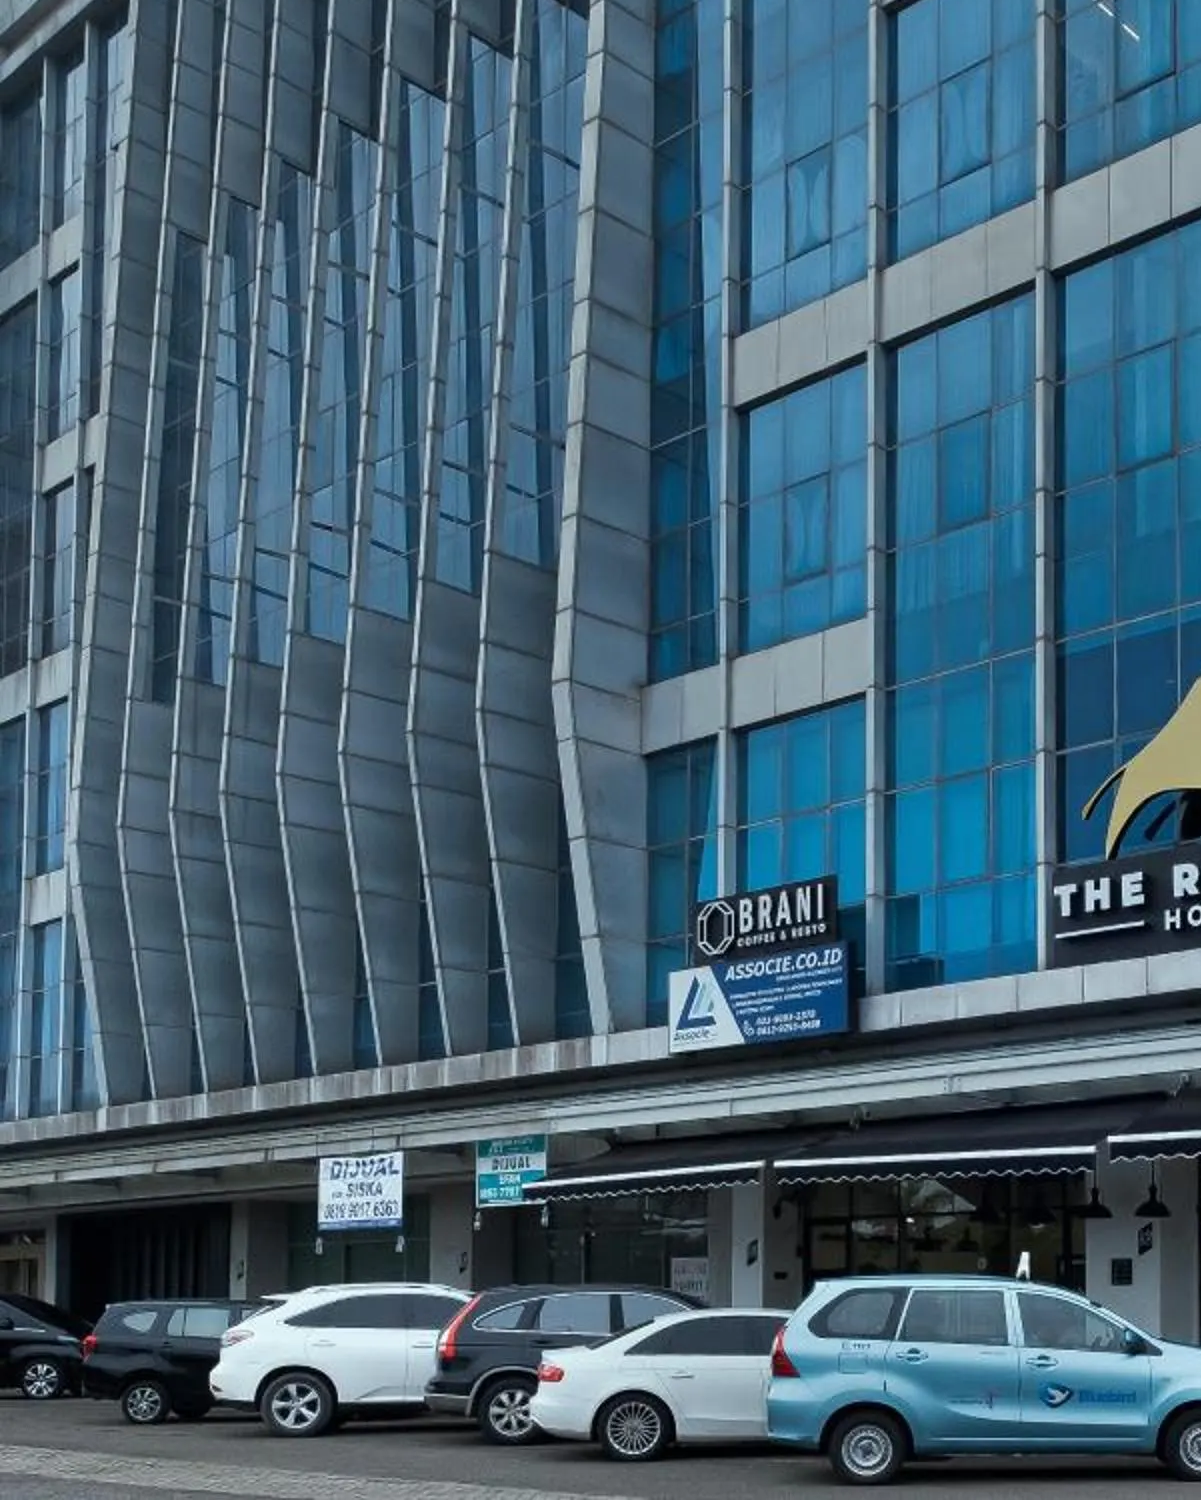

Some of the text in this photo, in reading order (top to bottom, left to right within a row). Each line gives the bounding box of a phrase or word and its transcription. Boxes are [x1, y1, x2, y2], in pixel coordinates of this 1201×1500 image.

[1054, 871, 1146, 917] THE
[739, 883, 824, 934] BRANI
[737, 931, 776, 947] COFFEE
[791, 923, 827, 938] RESTO
[724, 948, 843, 981] ASSOCIE.CO.ID
[330, 1156, 399, 1180] DIJUAL
[491, 1156, 531, 1171] DIJUAL
[346, 1182, 383, 1198] SISKA
